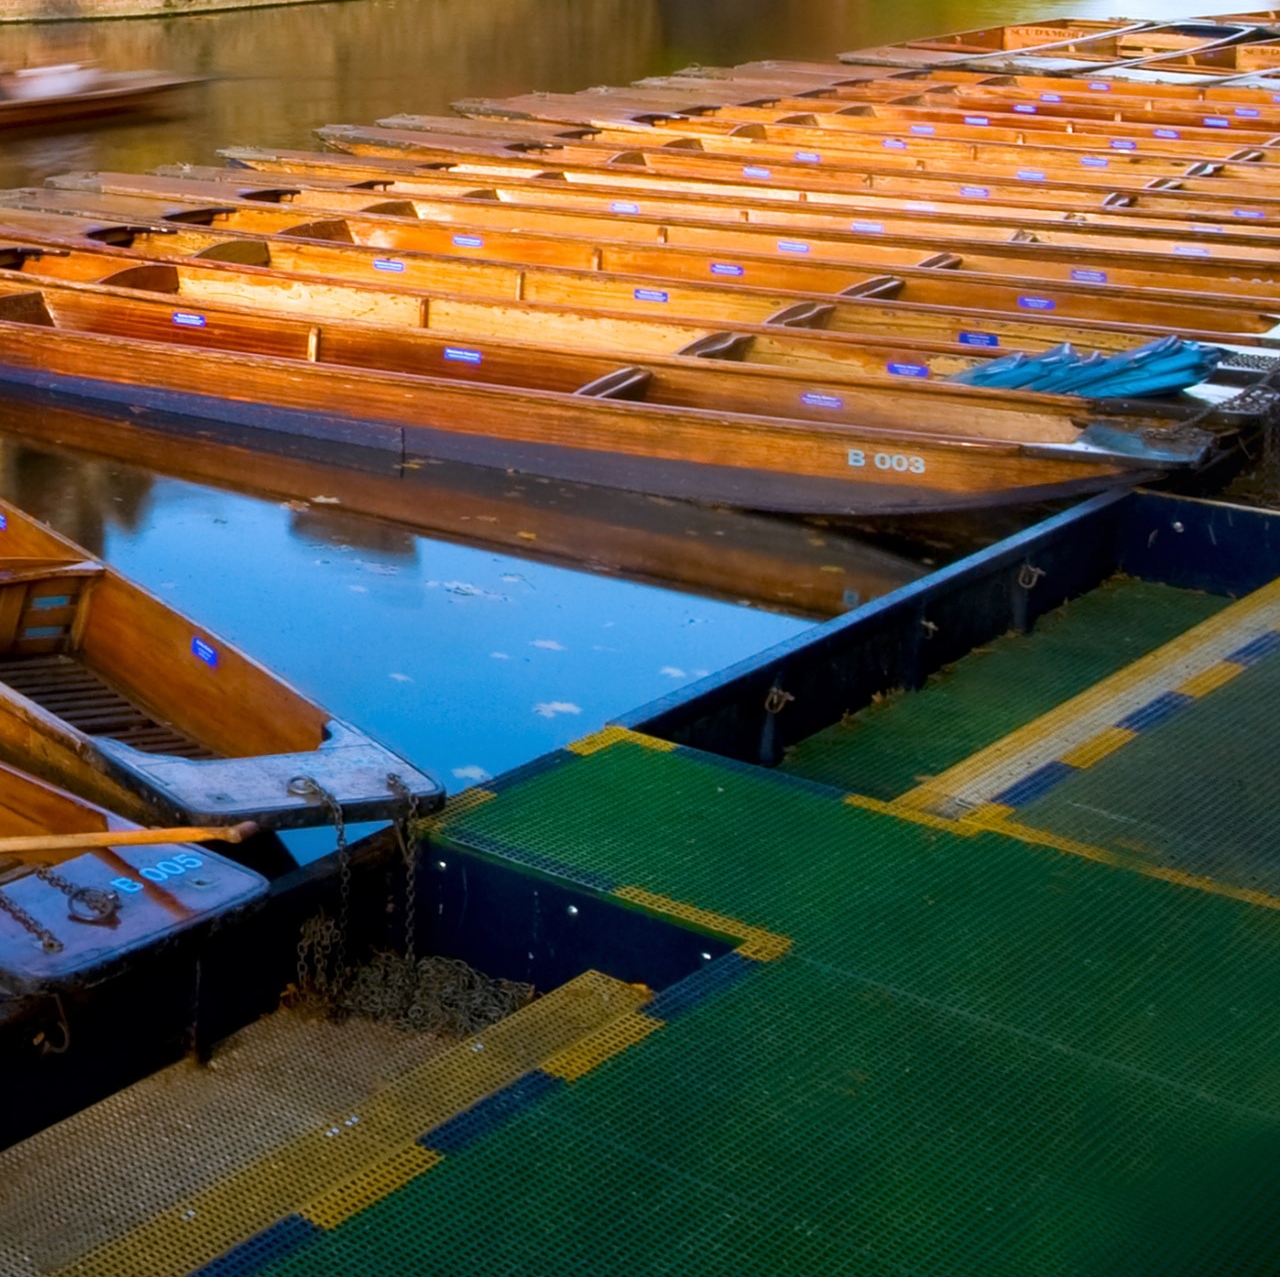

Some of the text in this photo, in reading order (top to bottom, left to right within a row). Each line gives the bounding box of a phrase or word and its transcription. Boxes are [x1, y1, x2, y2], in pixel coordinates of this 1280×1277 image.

[847, 449, 926, 474] B 003
[108, 853, 203, 893] B 005
